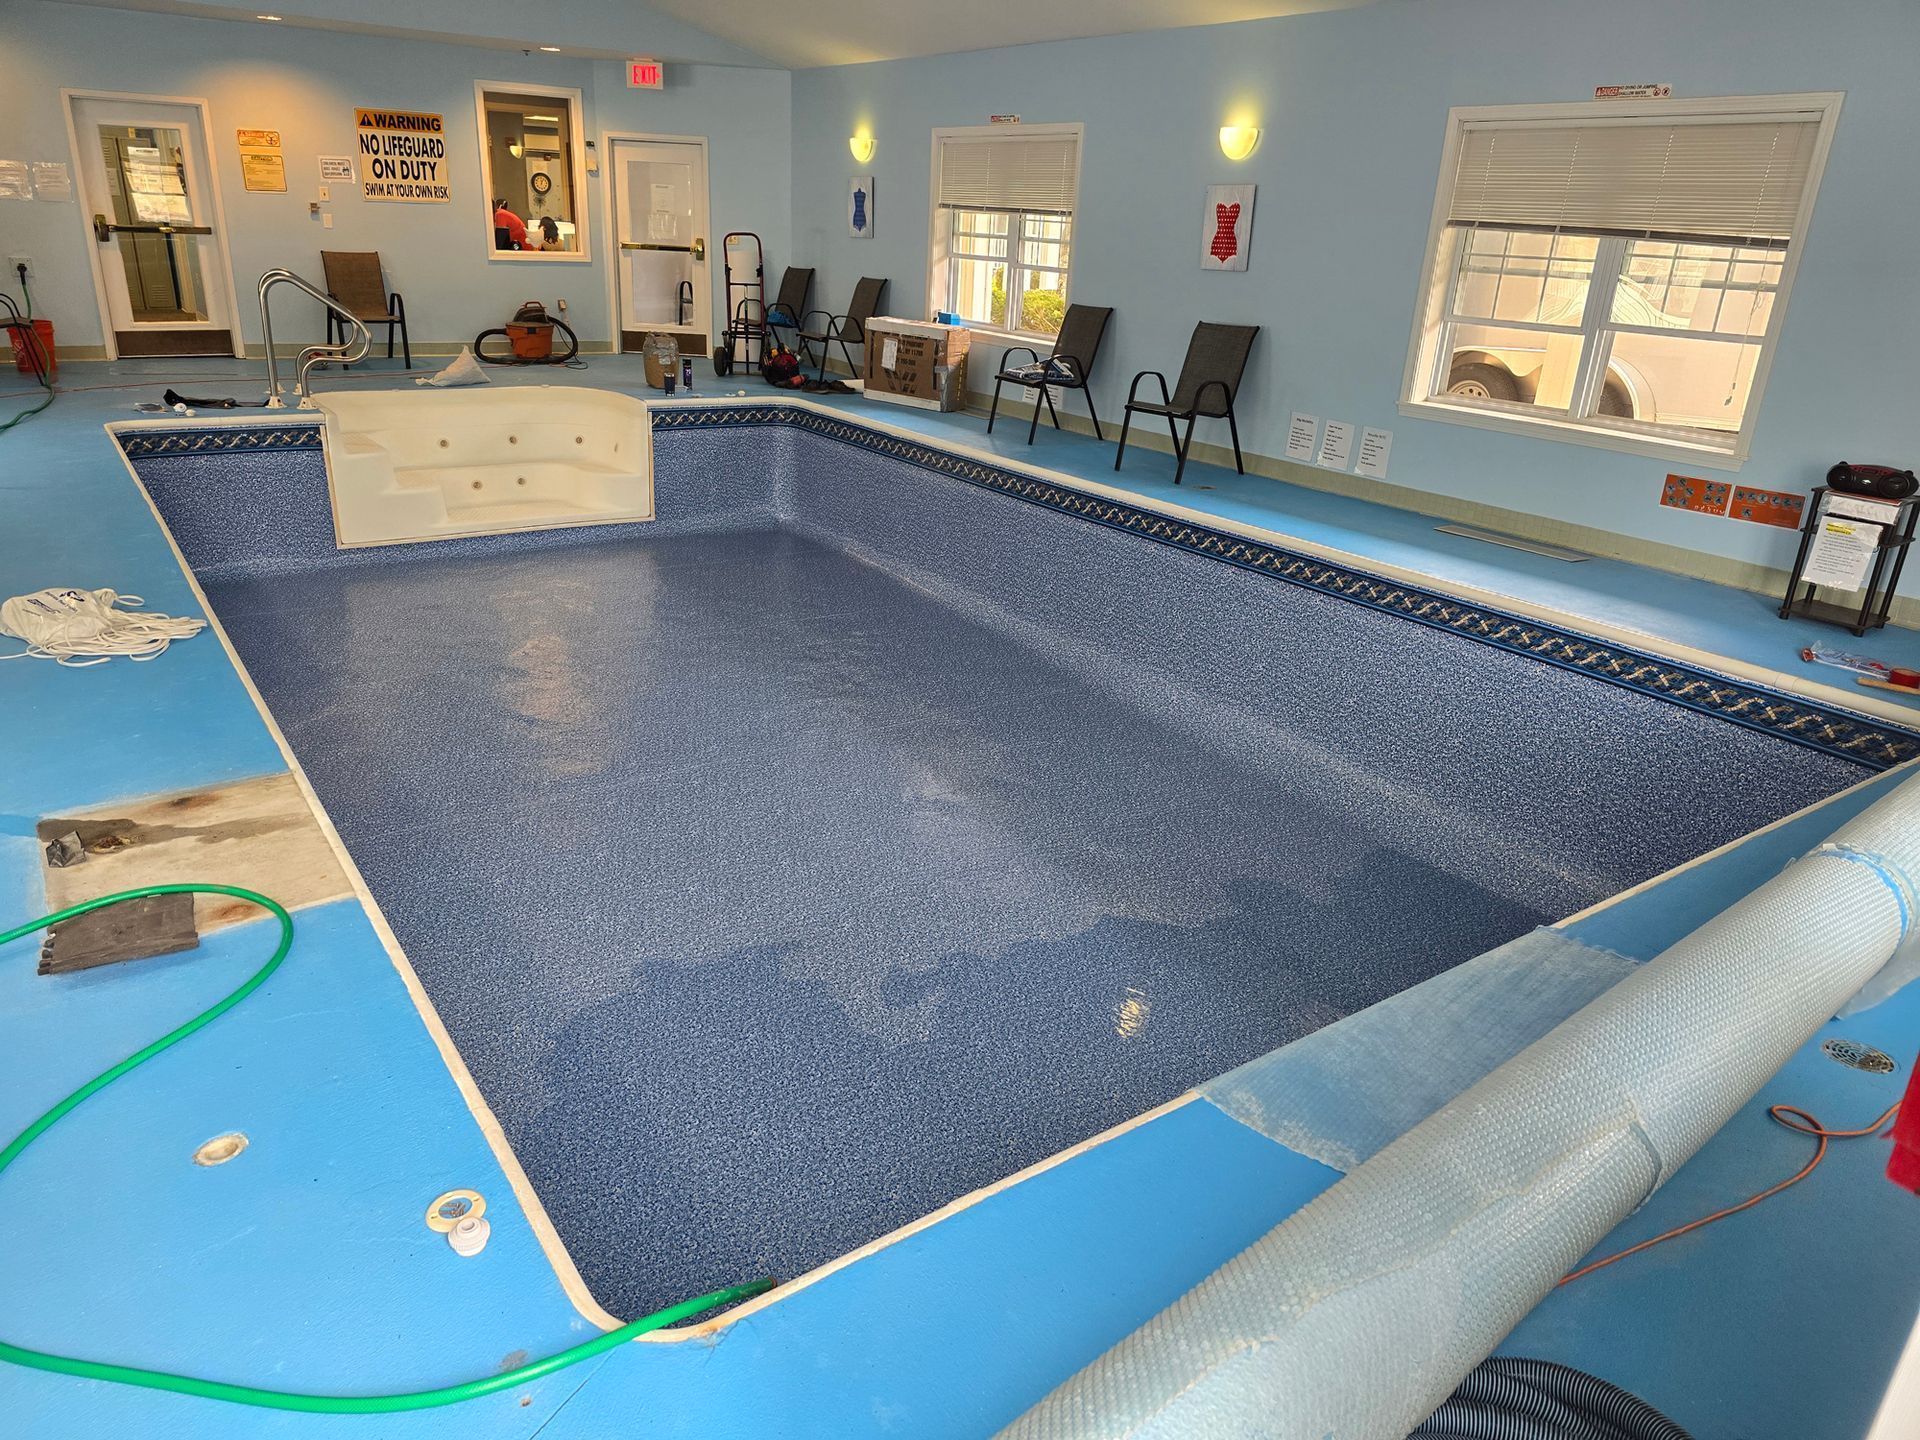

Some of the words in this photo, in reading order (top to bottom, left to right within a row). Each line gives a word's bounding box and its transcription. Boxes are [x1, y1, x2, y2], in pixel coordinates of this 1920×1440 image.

[633, 64, 656, 85] EXIT
[373, 113, 441, 131] WARNING
[360, 133, 380, 155] NO
[382, 135, 444, 158] LIFEGUARD
[372, 158, 397, 179] ON
[400, 160, 437, 181] DUTY
[365, 182, 385, 196] SWIM
[387, 183, 394, 196] AT
[395, 184, 414, 197] YOUR
[415, 185, 433, 198] OWN
[434, 186, 449, 199] RISK
